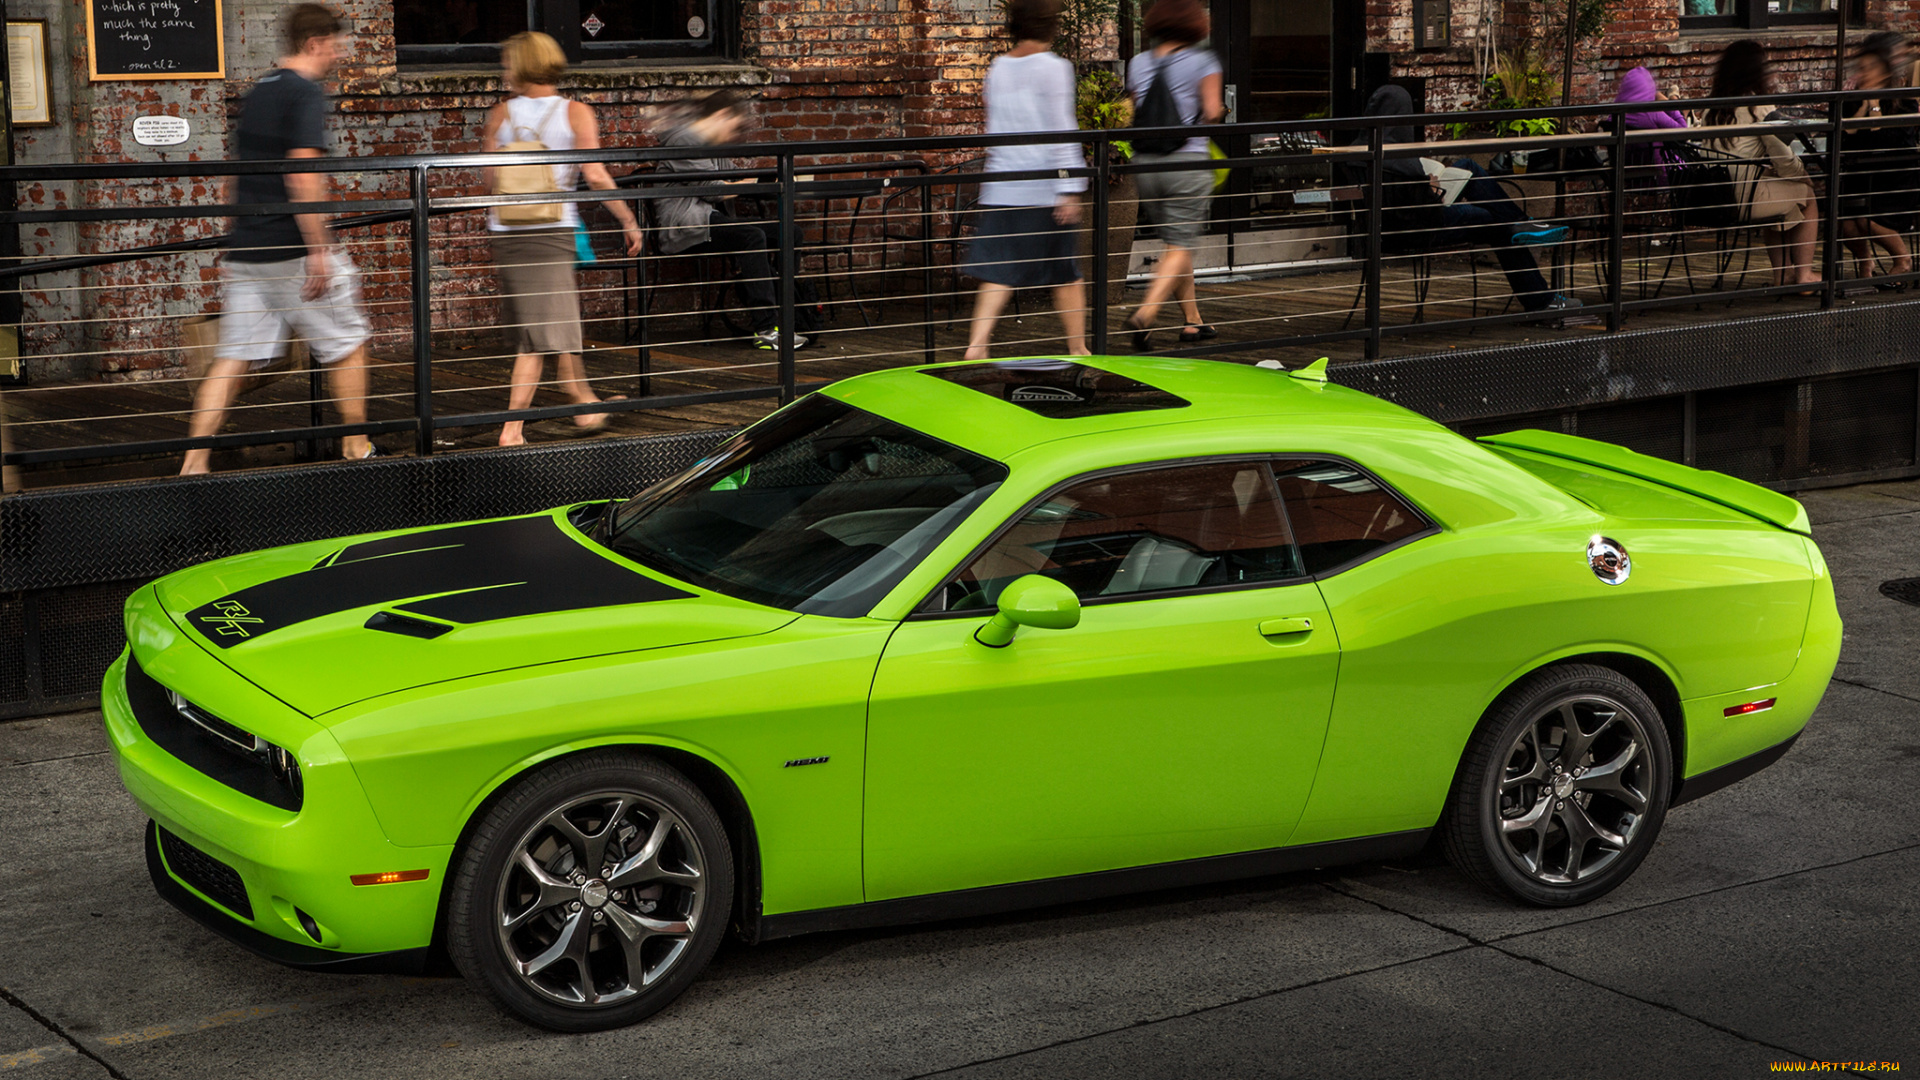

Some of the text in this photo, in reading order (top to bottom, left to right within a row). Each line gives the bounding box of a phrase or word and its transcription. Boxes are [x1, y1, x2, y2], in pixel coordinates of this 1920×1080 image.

[101, 0, 181, 18] which is pretty
[103, 18, 195, 30] much the same
[128, 62, 151, 71] open
[200, 600, 264, 637] R/T
